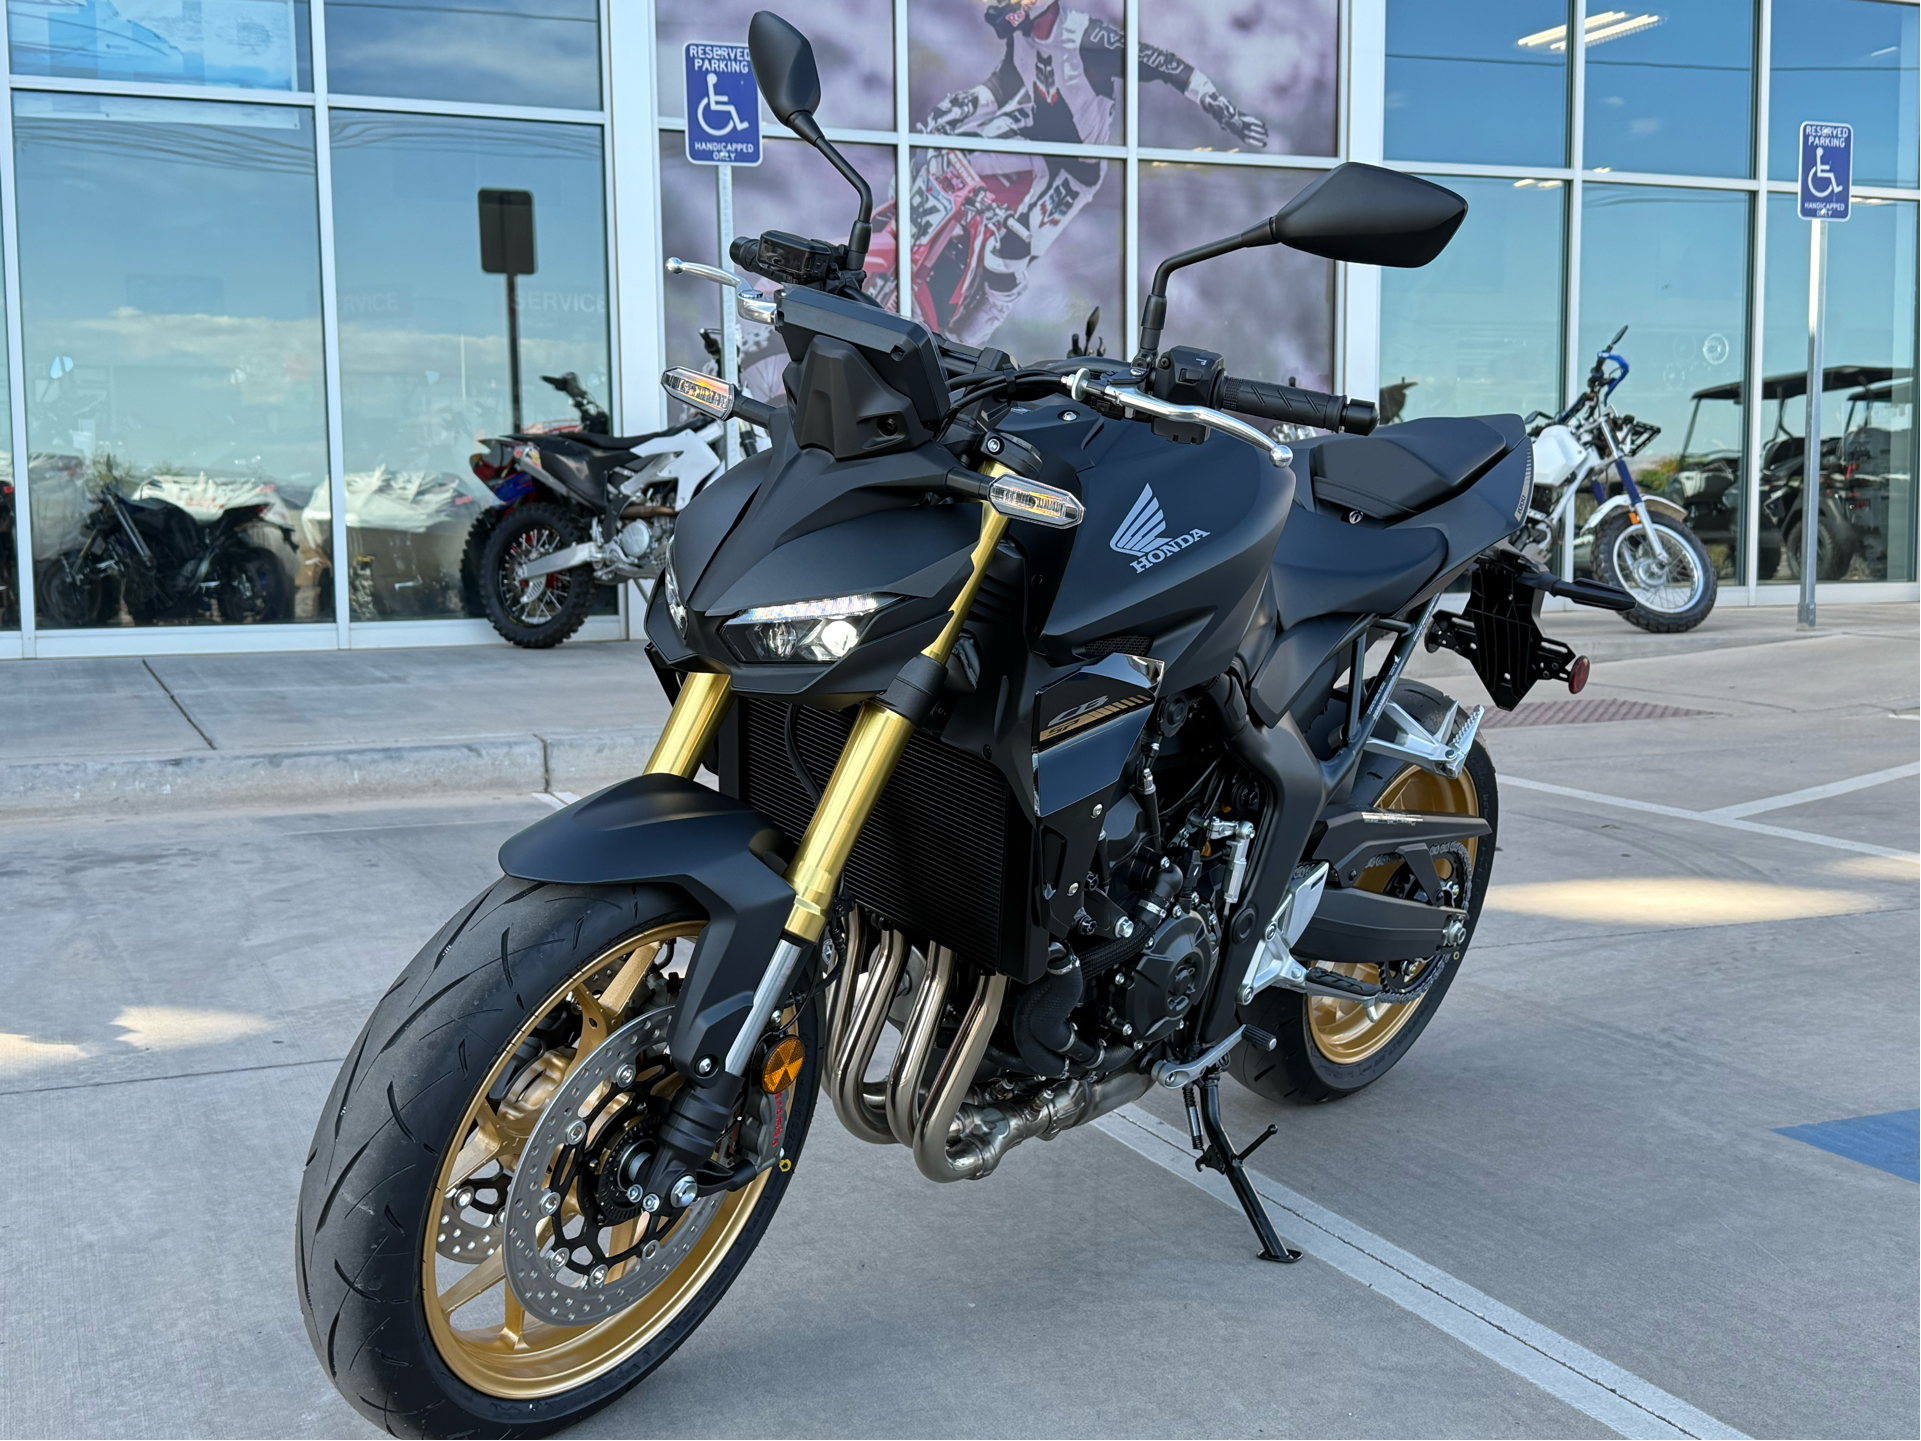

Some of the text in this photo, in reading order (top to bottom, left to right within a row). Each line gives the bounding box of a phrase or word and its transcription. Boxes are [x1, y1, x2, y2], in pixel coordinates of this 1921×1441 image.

[689, 45, 751, 61] RESERVED
[694, 58, 749, 73] PARKING
[1805, 125, 1849, 138] RESERVED
[694, 141, 755, 153] HANDICAPPED
[1808, 136, 1846, 148] PARKING
[1805, 202, 1845, 211] HANDICAPPED
[512, 290, 605, 314] SERVICE
[1130, 528, 1211, 574] HONDA
[1047, 695, 1109, 727] CB
[1046, 718, 1081, 738] SP
